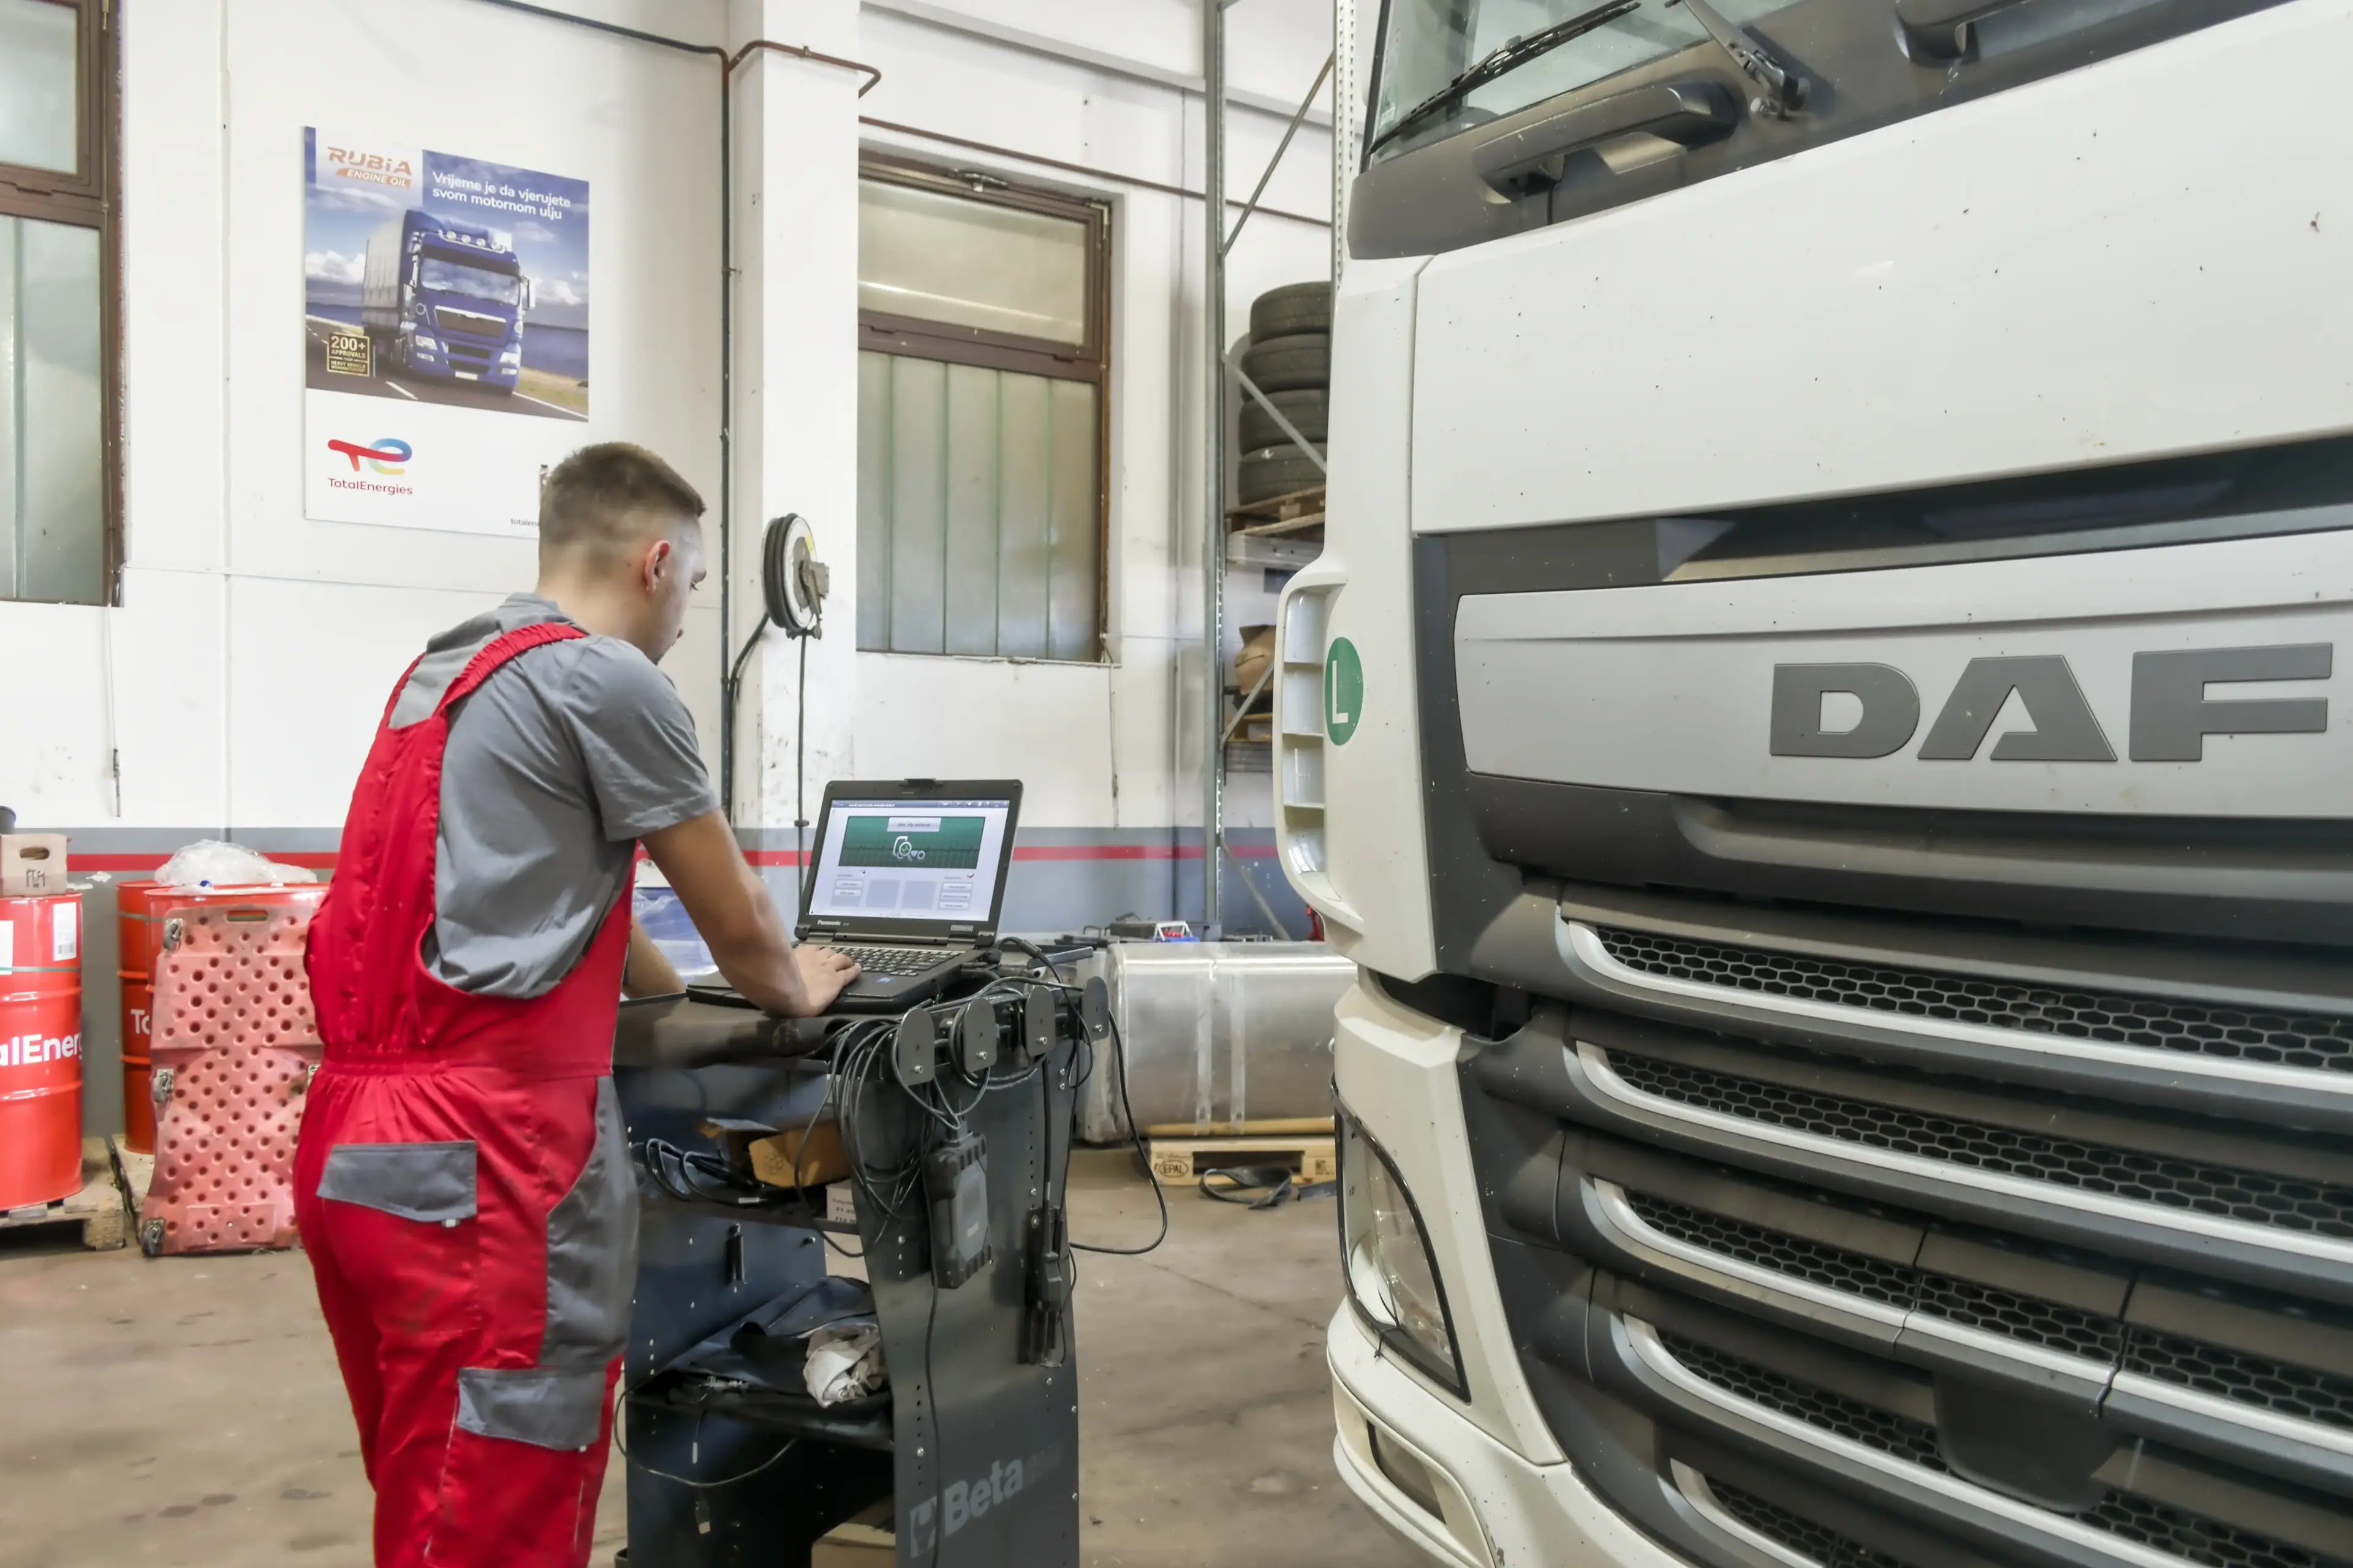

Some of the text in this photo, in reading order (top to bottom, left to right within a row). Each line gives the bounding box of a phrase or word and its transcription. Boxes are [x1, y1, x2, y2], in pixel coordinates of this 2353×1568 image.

[347, 169, 407, 187] ENGINE OIL
[433, 171, 571, 208] Vrijeme je da vjerujete
[433, 187, 562, 221] svom motornom ulju
[331, 335, 366, 352] 200+
[327, 477, 413, 496] TotalEnergies
[1332, 660, 1349, 724] L
[1770, 642, 2333, 762] DAF
[944, 1458, 1023, 1537] Beta
